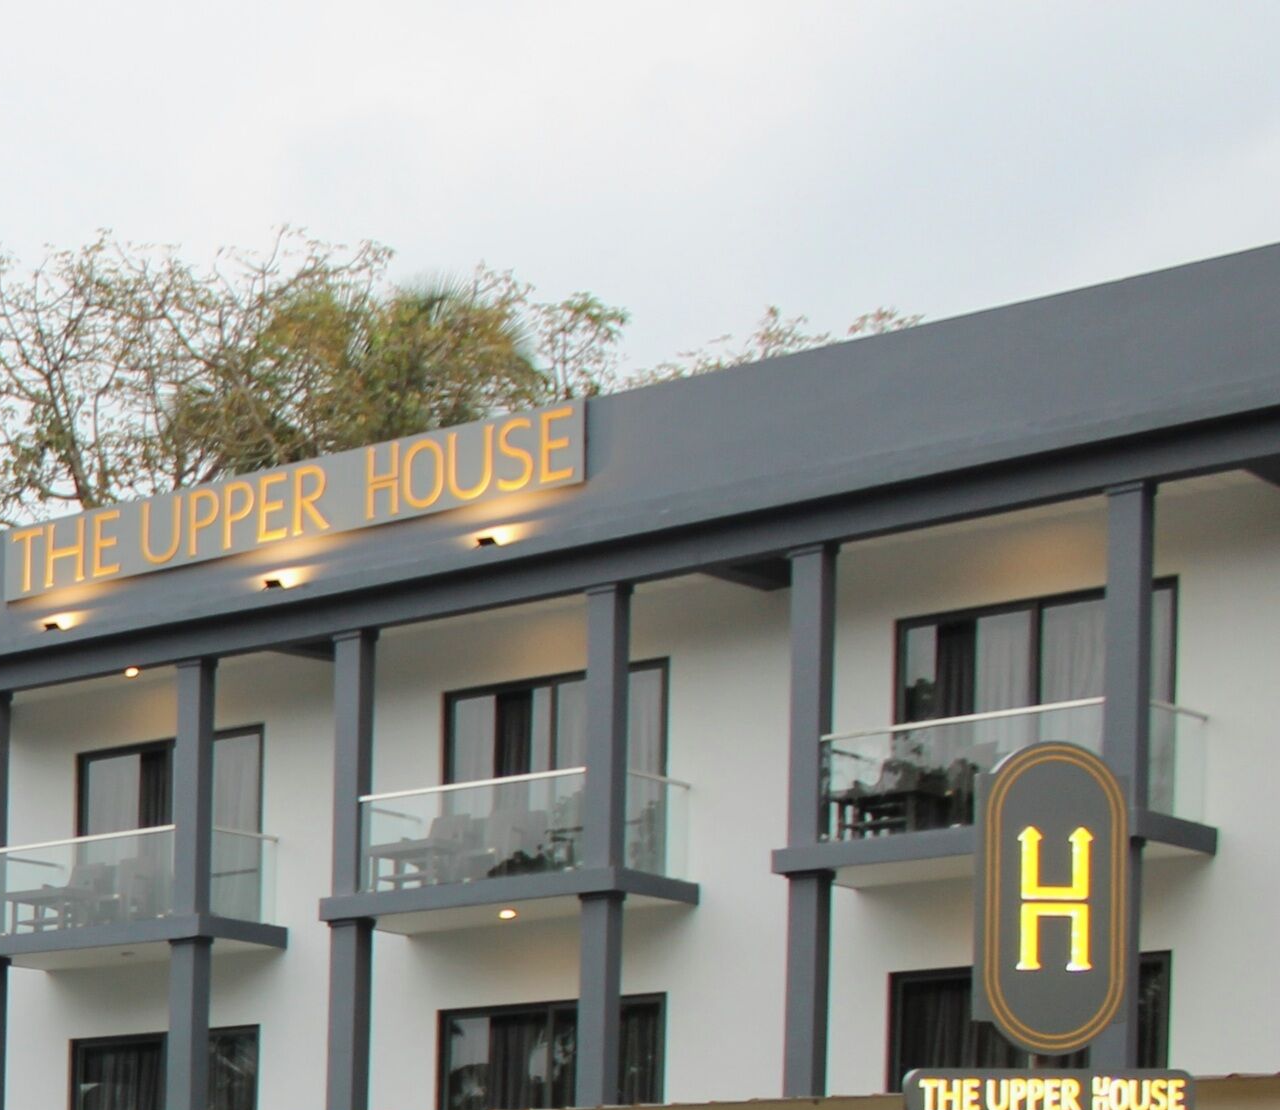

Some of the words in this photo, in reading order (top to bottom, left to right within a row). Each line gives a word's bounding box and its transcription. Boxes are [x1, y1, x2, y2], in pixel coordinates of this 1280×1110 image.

[11, 509, 121, 592] THE
[142, 463, 330, 566] UPPER
[365, 405, 576, 520] HOUSE
